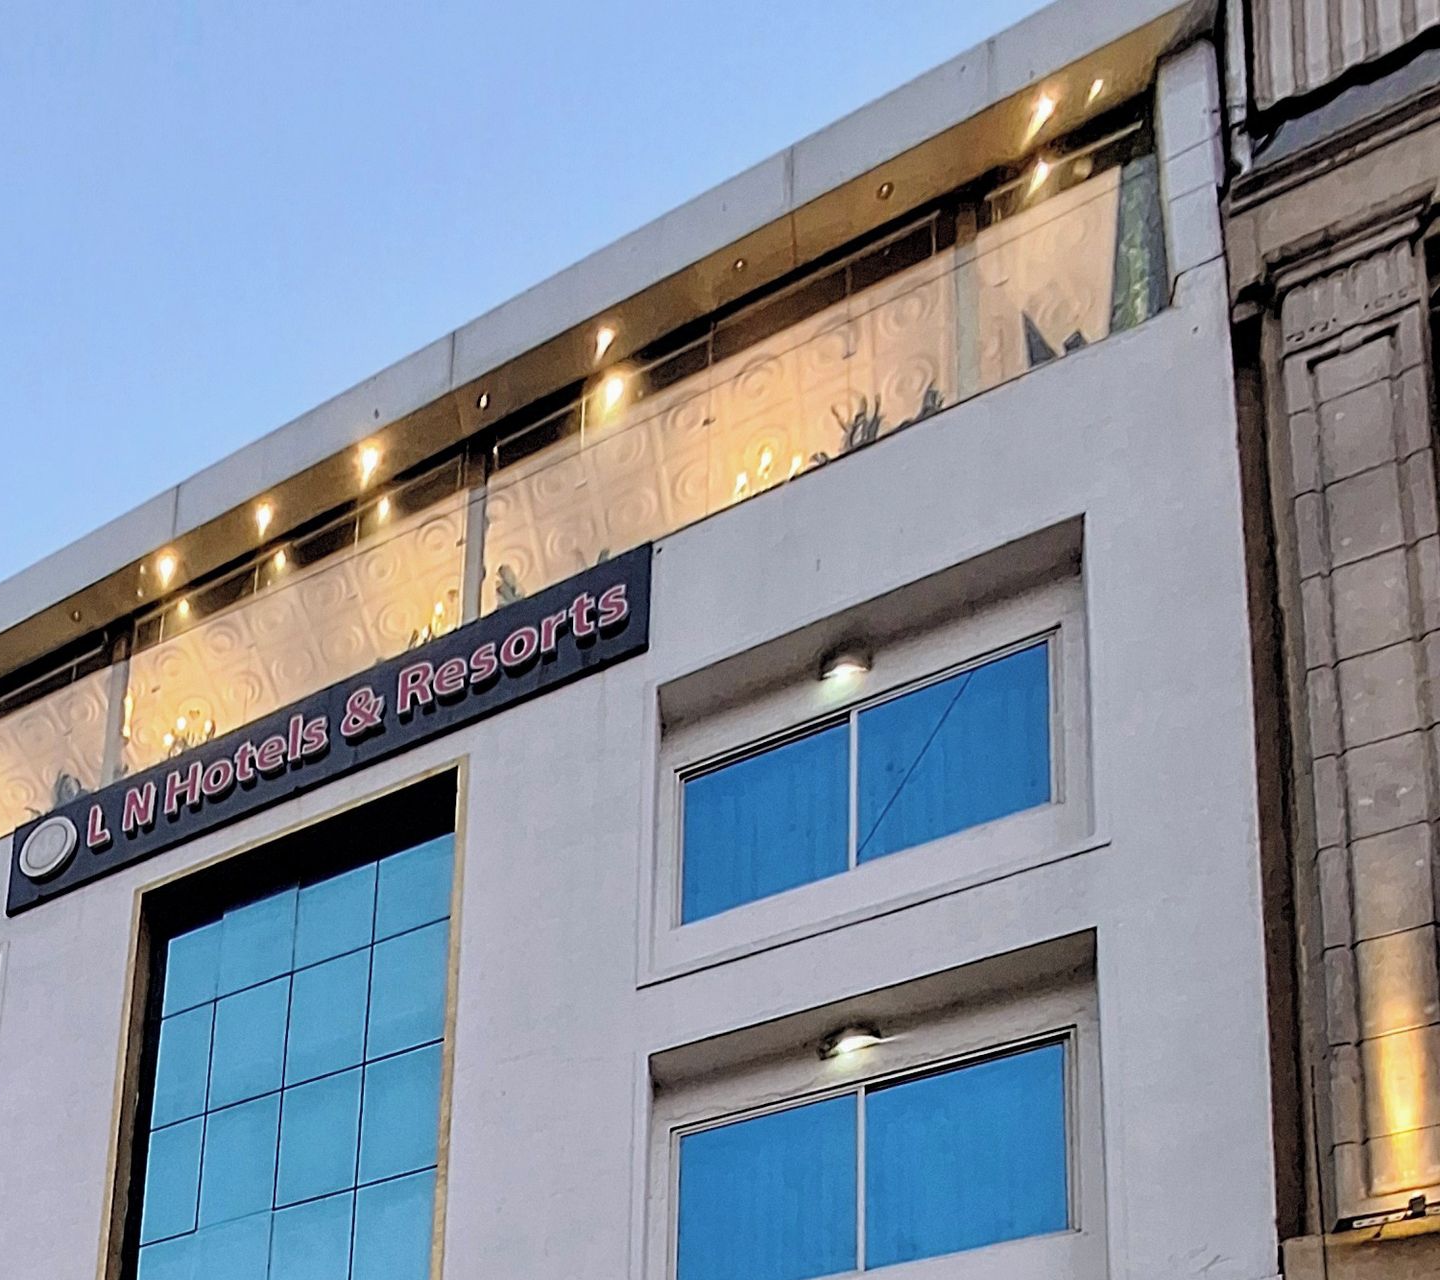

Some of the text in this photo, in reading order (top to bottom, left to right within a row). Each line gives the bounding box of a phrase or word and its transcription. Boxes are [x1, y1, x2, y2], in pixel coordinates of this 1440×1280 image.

[87, 583, 628, 847] L N Hotels & Resorts
